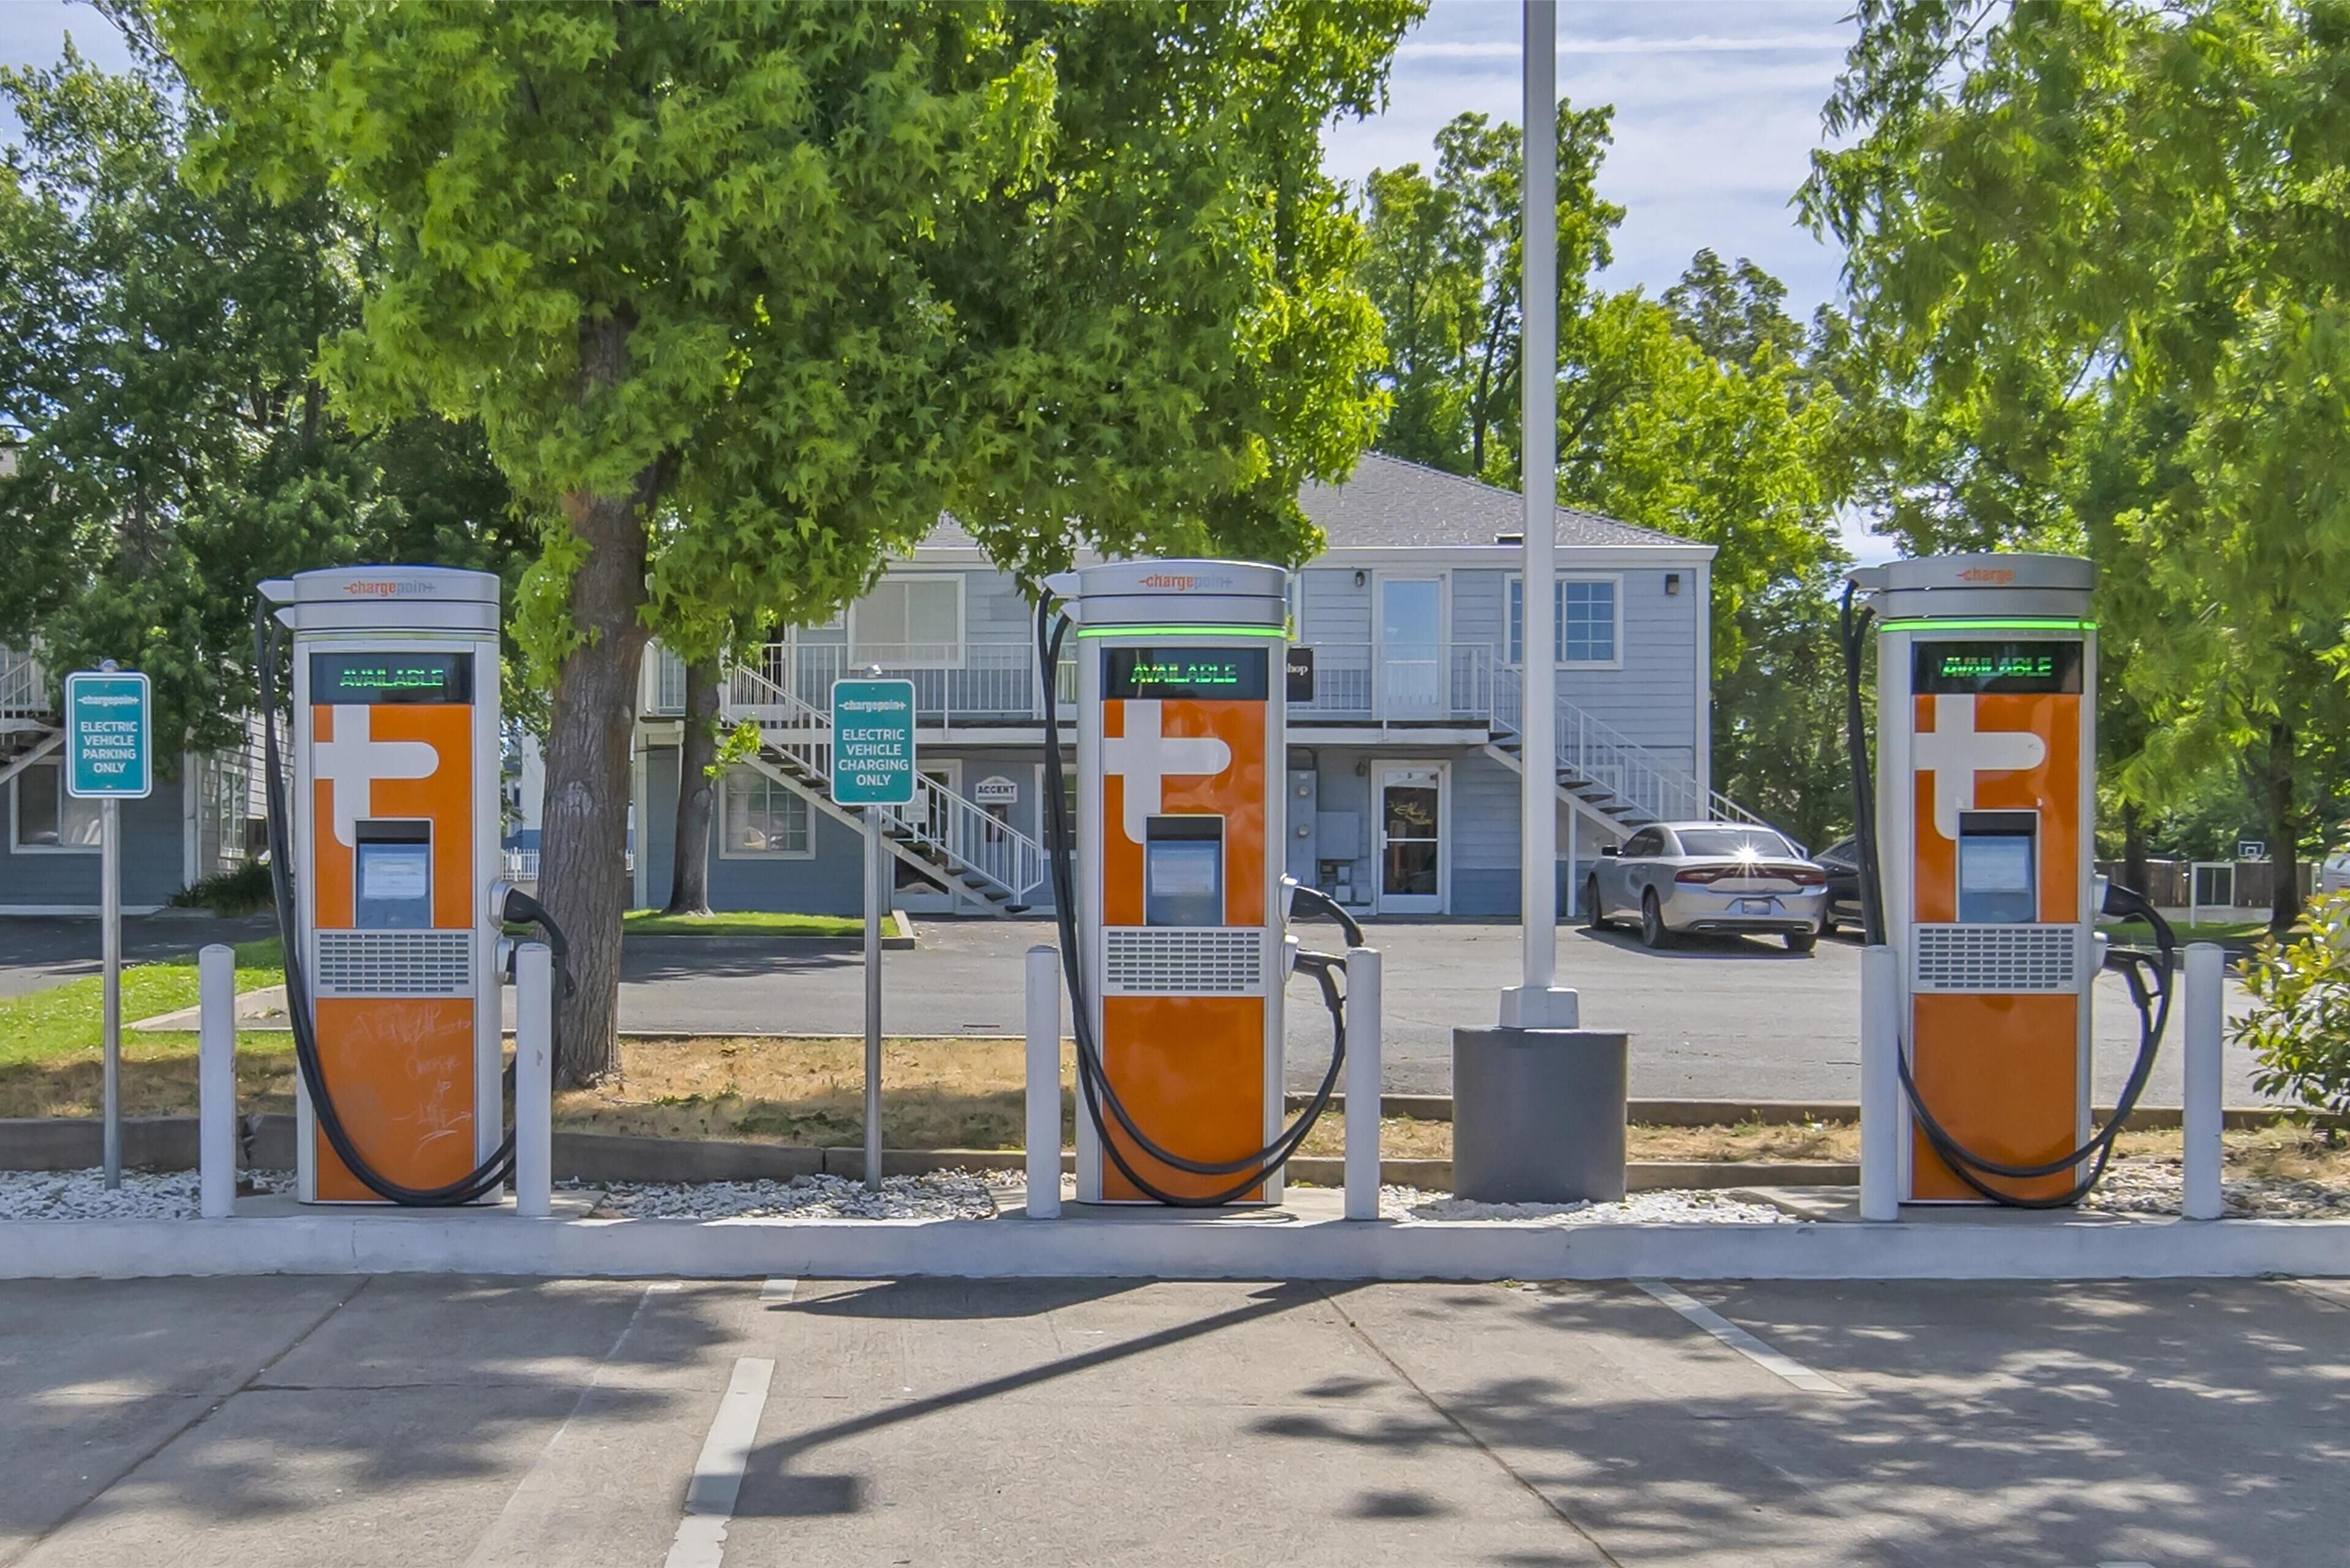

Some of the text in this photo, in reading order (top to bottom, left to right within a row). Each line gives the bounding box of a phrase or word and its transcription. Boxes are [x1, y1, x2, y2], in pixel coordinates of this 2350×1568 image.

[339, 669, 443, 687] AVAILABLE
[1131, 663, 1237, 683] AVAILABLE
[838, 699, 906, 712] chargepoint
[80, 722, 138, 733] ELECTRIC
[84, 735, 135, 746] VEHICLE
[842, 729, 905, 741] ELECTRIC
[83, 748, 137, 760] PARKING
[846, 744, 902, 755] VEHICLE
[93, 762, 126, 774] ONLY
[838, 759, 909, 771] CHARGING
[856, 774, 891, 786] ONLY
[977, 785, 1015, 794] ACCENT
